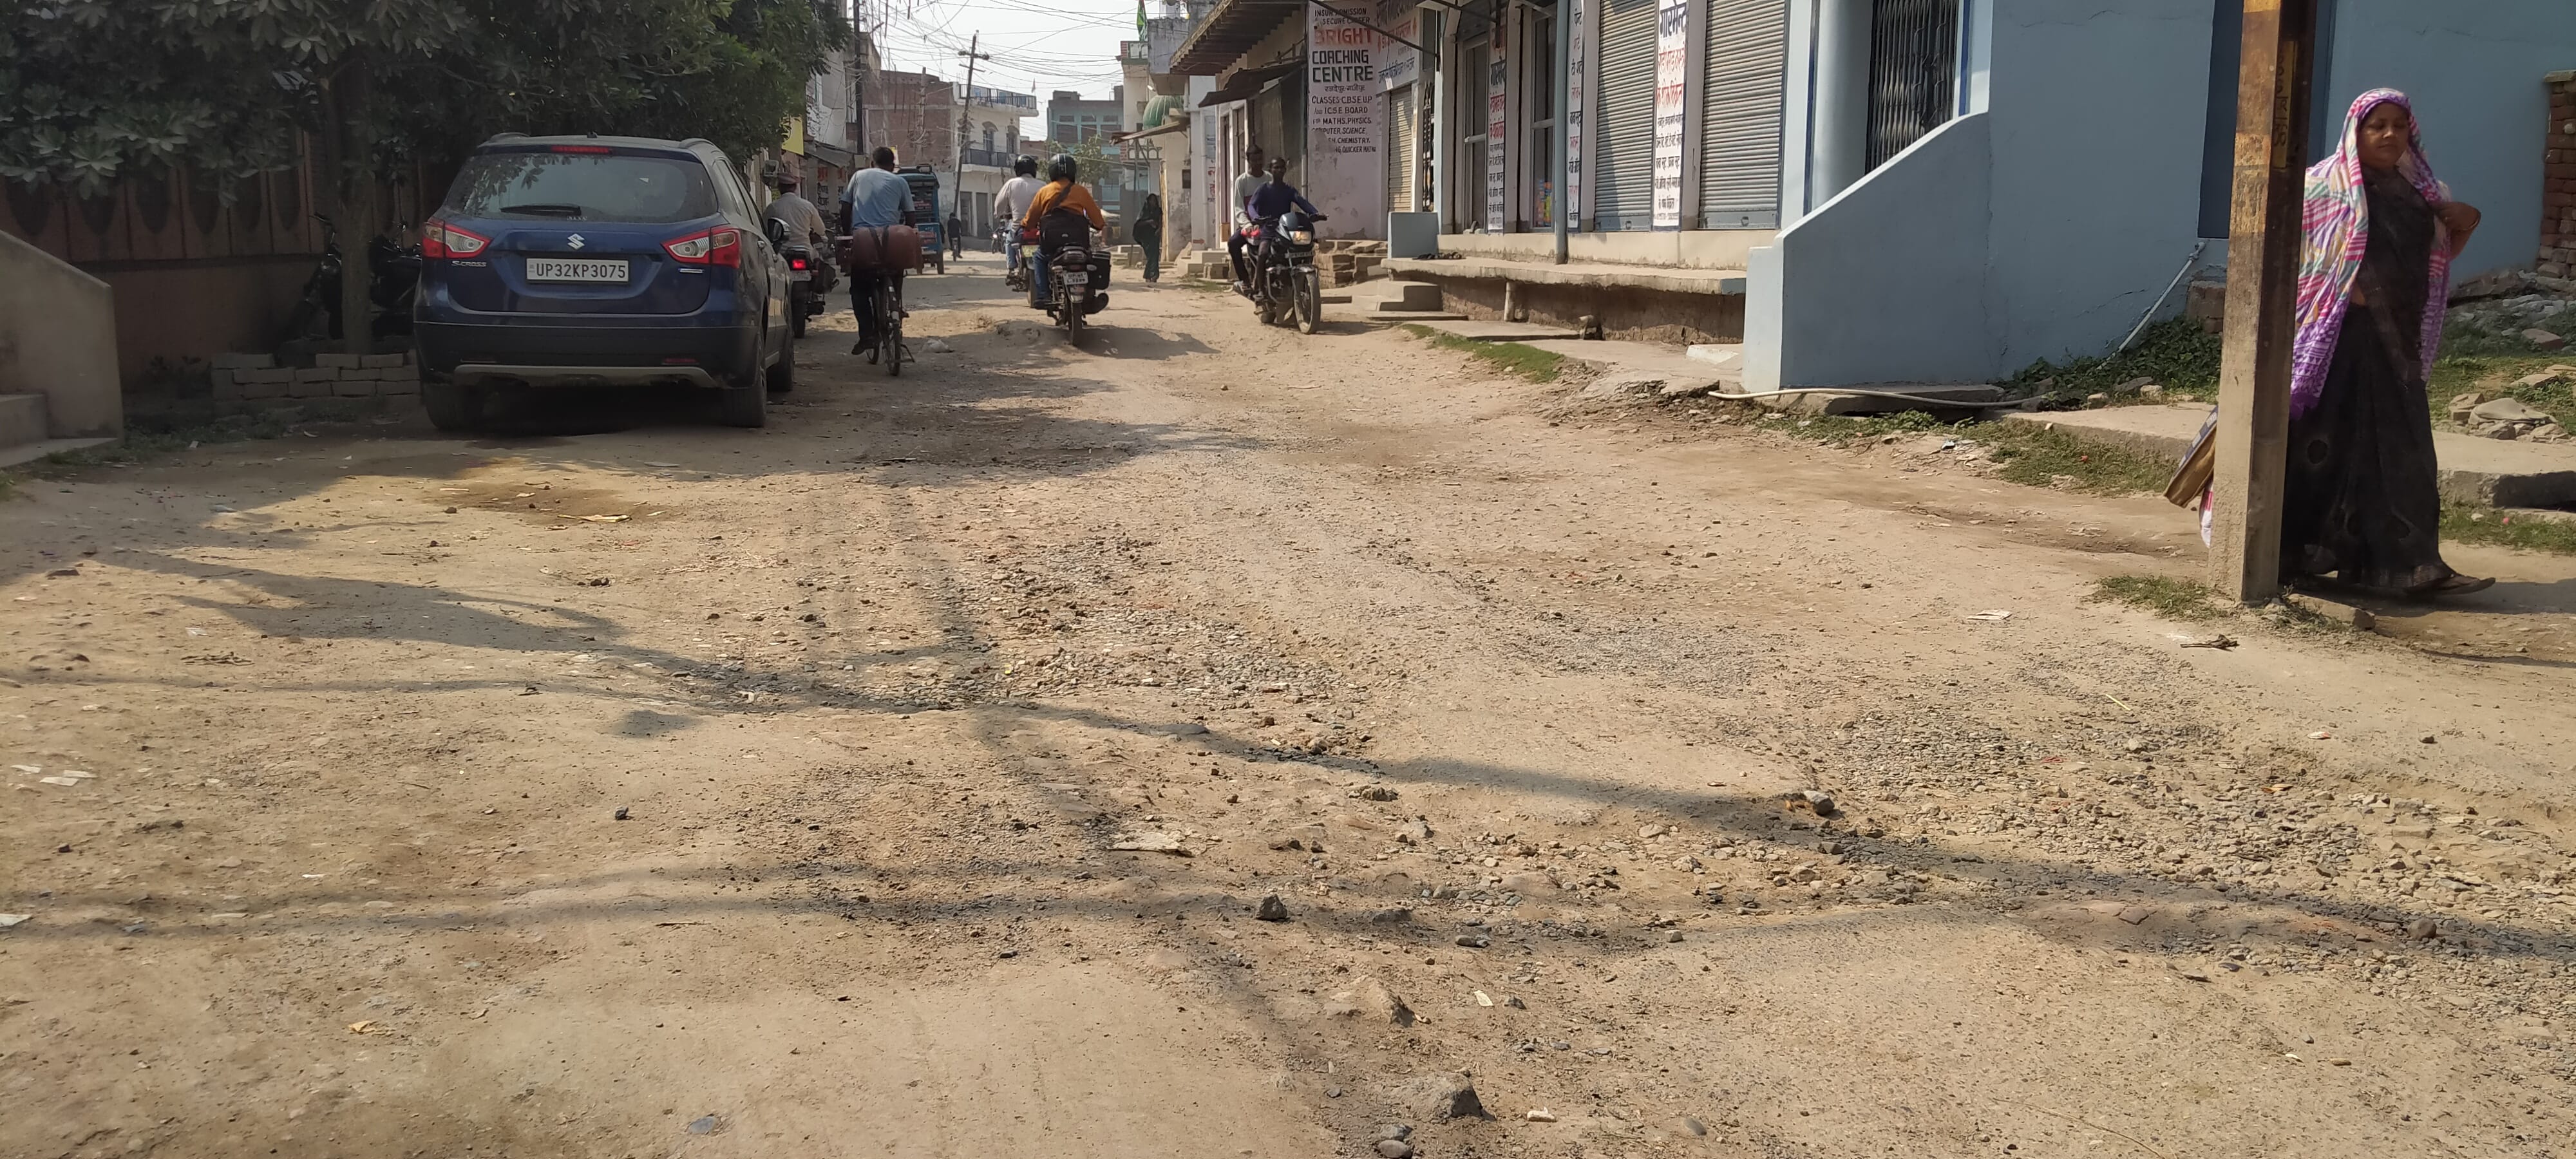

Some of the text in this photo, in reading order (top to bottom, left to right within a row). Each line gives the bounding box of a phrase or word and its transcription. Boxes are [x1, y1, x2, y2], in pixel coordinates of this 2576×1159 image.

[1314, 27, 1372, 44] BRIGHT
[1312, 50, 1369, 64] COACHING
[1312, 65, 1374, 82] CENTRE
[536, 263, 626, 279] UP32KP3075
